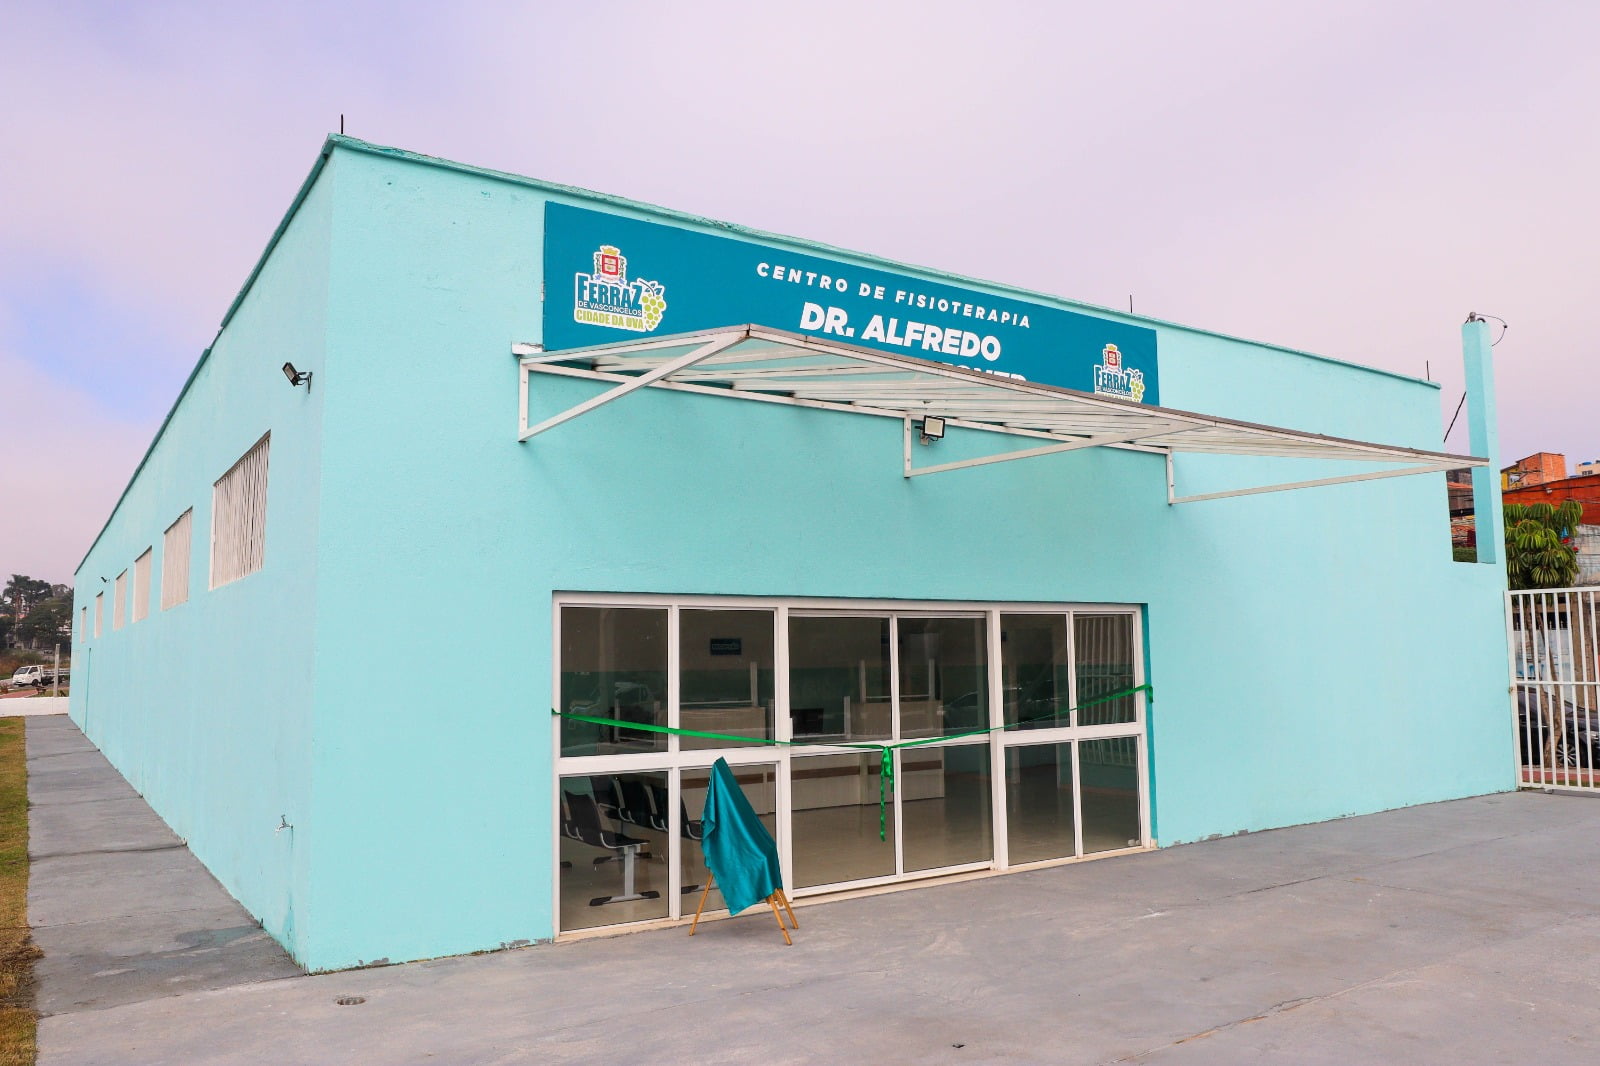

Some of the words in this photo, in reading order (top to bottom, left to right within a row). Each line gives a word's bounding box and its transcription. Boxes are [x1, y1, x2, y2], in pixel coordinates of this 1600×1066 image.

[577, 275, 643, 309] FERRAZ
[756, 262, 848, 292] CENTRO
[858, 283, 886, 300] DE
[895, 290, 1030, 328] FISIOTERAPIA
[576, 309, 611, 326] CIDADE
[611, 315, 624, 328] DA
[626, 317, 644, 330] UVA
[578, 300, 588, 308] DE
[589, 302, 642, 317] VASCONCELOS
[800, 302, 855, 337] DR.
[861, 315, 1002, 362] ALFREDO
[1095, 366, 1132, 392] FERRAZ
